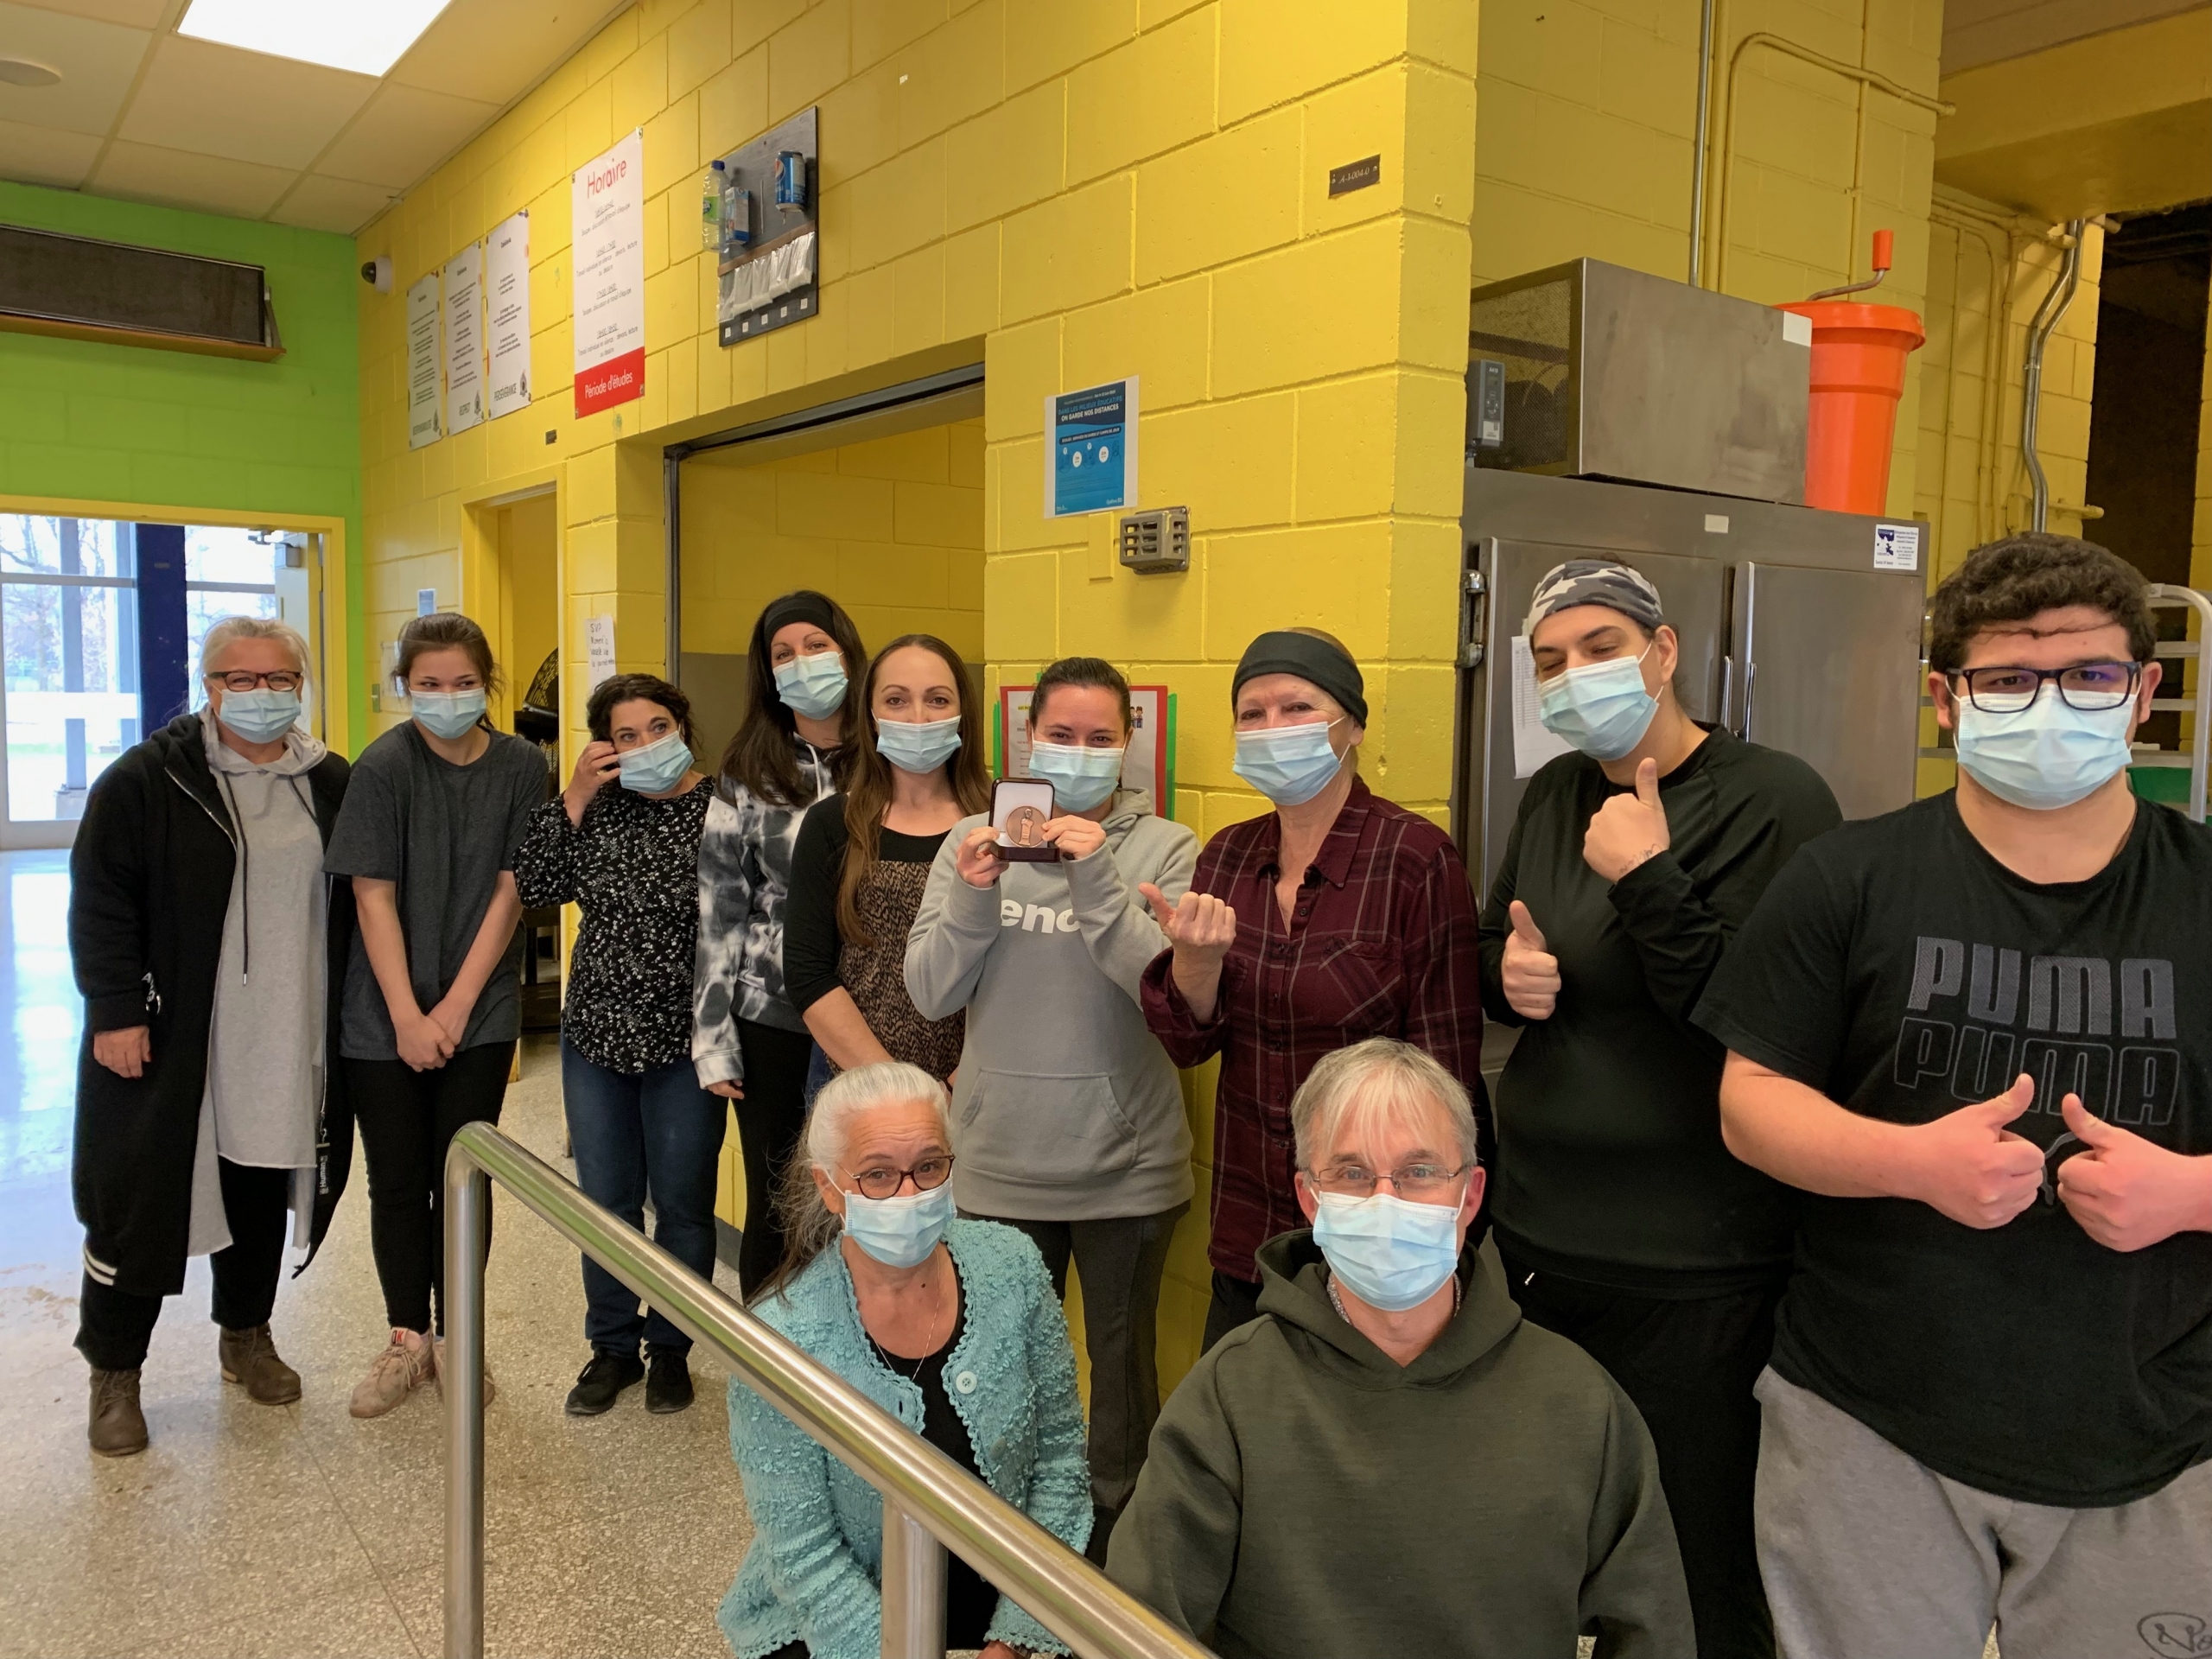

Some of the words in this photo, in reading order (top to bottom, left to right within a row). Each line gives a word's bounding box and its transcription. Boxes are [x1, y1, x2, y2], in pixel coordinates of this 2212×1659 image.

[587, 158, 627, 199] Horaire
[585, 378, 607, 399] Période
[607, 369, 633, 391] d'études
[1069, 411, 1084, 420] GARDE
[1094, 404, 1119, 414] DISTANCES
[590, 622, 602, 633] SVP
[1907, 936, 2177, 1039] PUMA
[1894, 1016, 2180, 1126] PUMA
